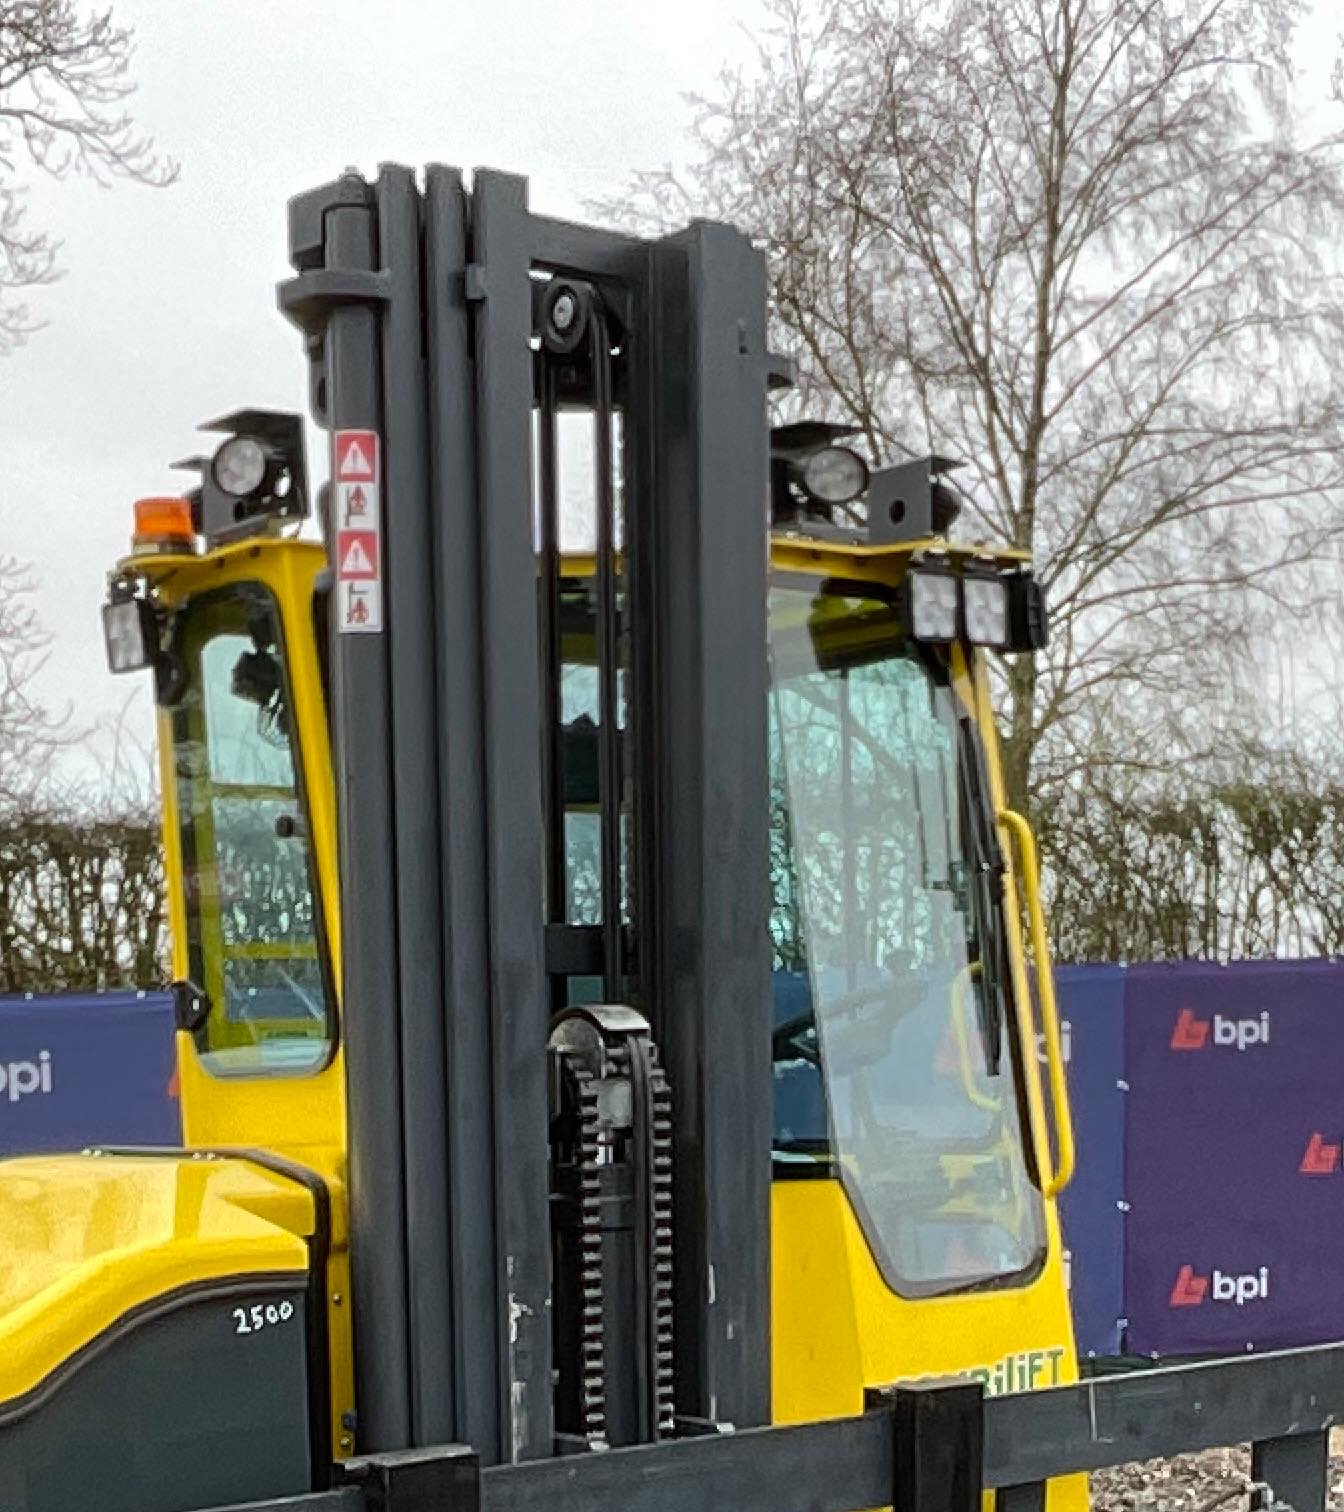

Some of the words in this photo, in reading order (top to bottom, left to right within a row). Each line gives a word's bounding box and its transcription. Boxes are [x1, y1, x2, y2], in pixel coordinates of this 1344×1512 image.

[1214, 1010, 1270, 1051] bpi
[1211, 1266, 1270, 1306] bpi
[232, 1300, 294, 1334] 2500
